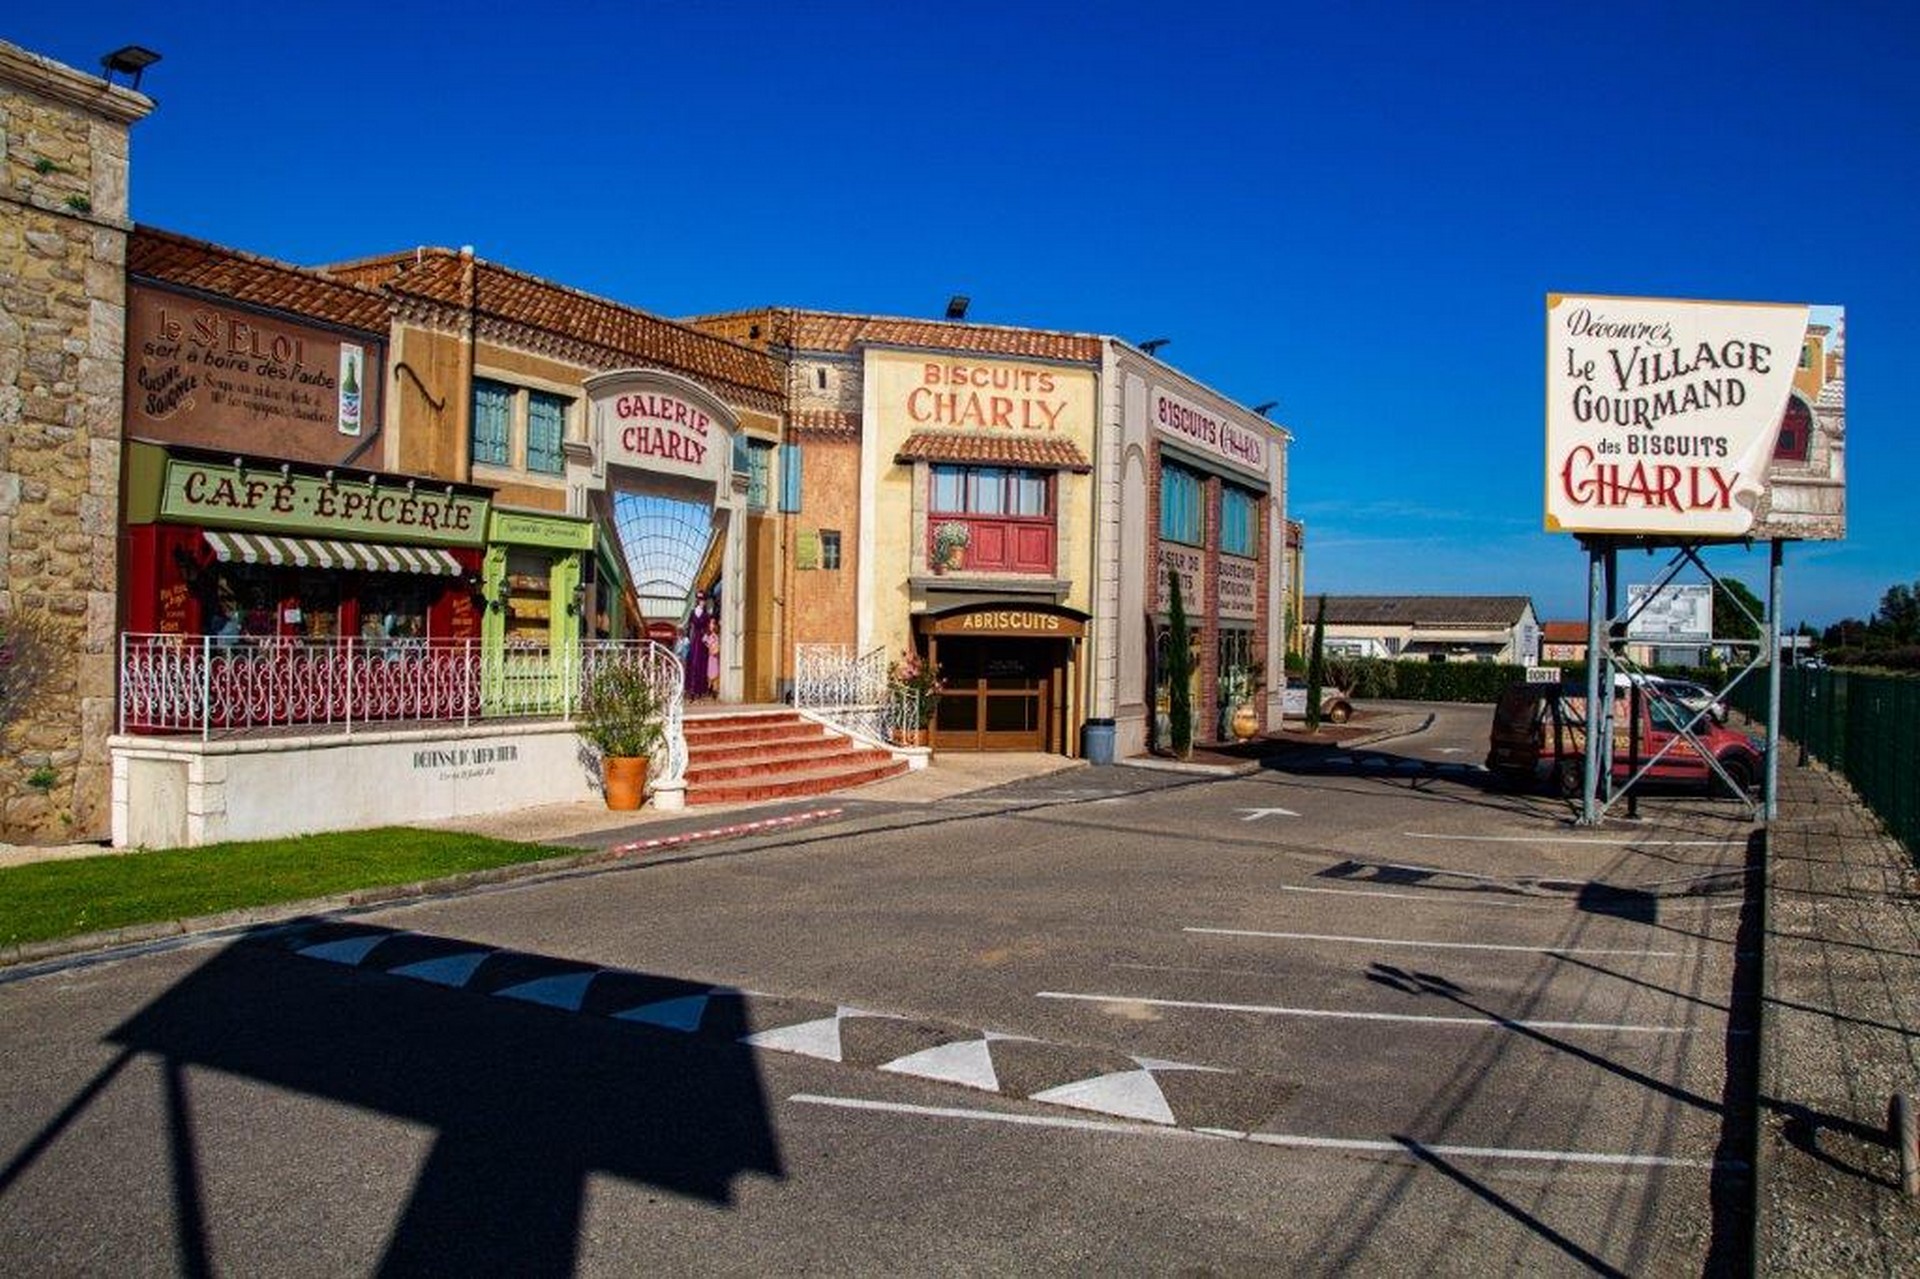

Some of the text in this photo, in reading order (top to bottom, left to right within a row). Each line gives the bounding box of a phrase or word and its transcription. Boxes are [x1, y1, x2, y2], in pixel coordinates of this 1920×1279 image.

[1567, 308, 1673, 347] Découvrez
[143, 341, 182, 361] sert
[203, 350, 253, 373] boire
[1567, 340, 1772, 392] Le VILLAGE
[923, 363, 1056, 394] BISCUITS
[616, 395, 710, 437] GALERIE
[907, 387, 1068, 432] CHARLY
[1158, 396, 1217, 445] BISCUITS
[1573, 378, 1746, 430] GOURMAND
[622, 426, 708, 464] CHARLY
[1597, 434, 1728, 458] des BISCUITS
[1561, 445, 1741, 513] CHARLY
[962, 610, 1060, 630] ABRISCUITS
